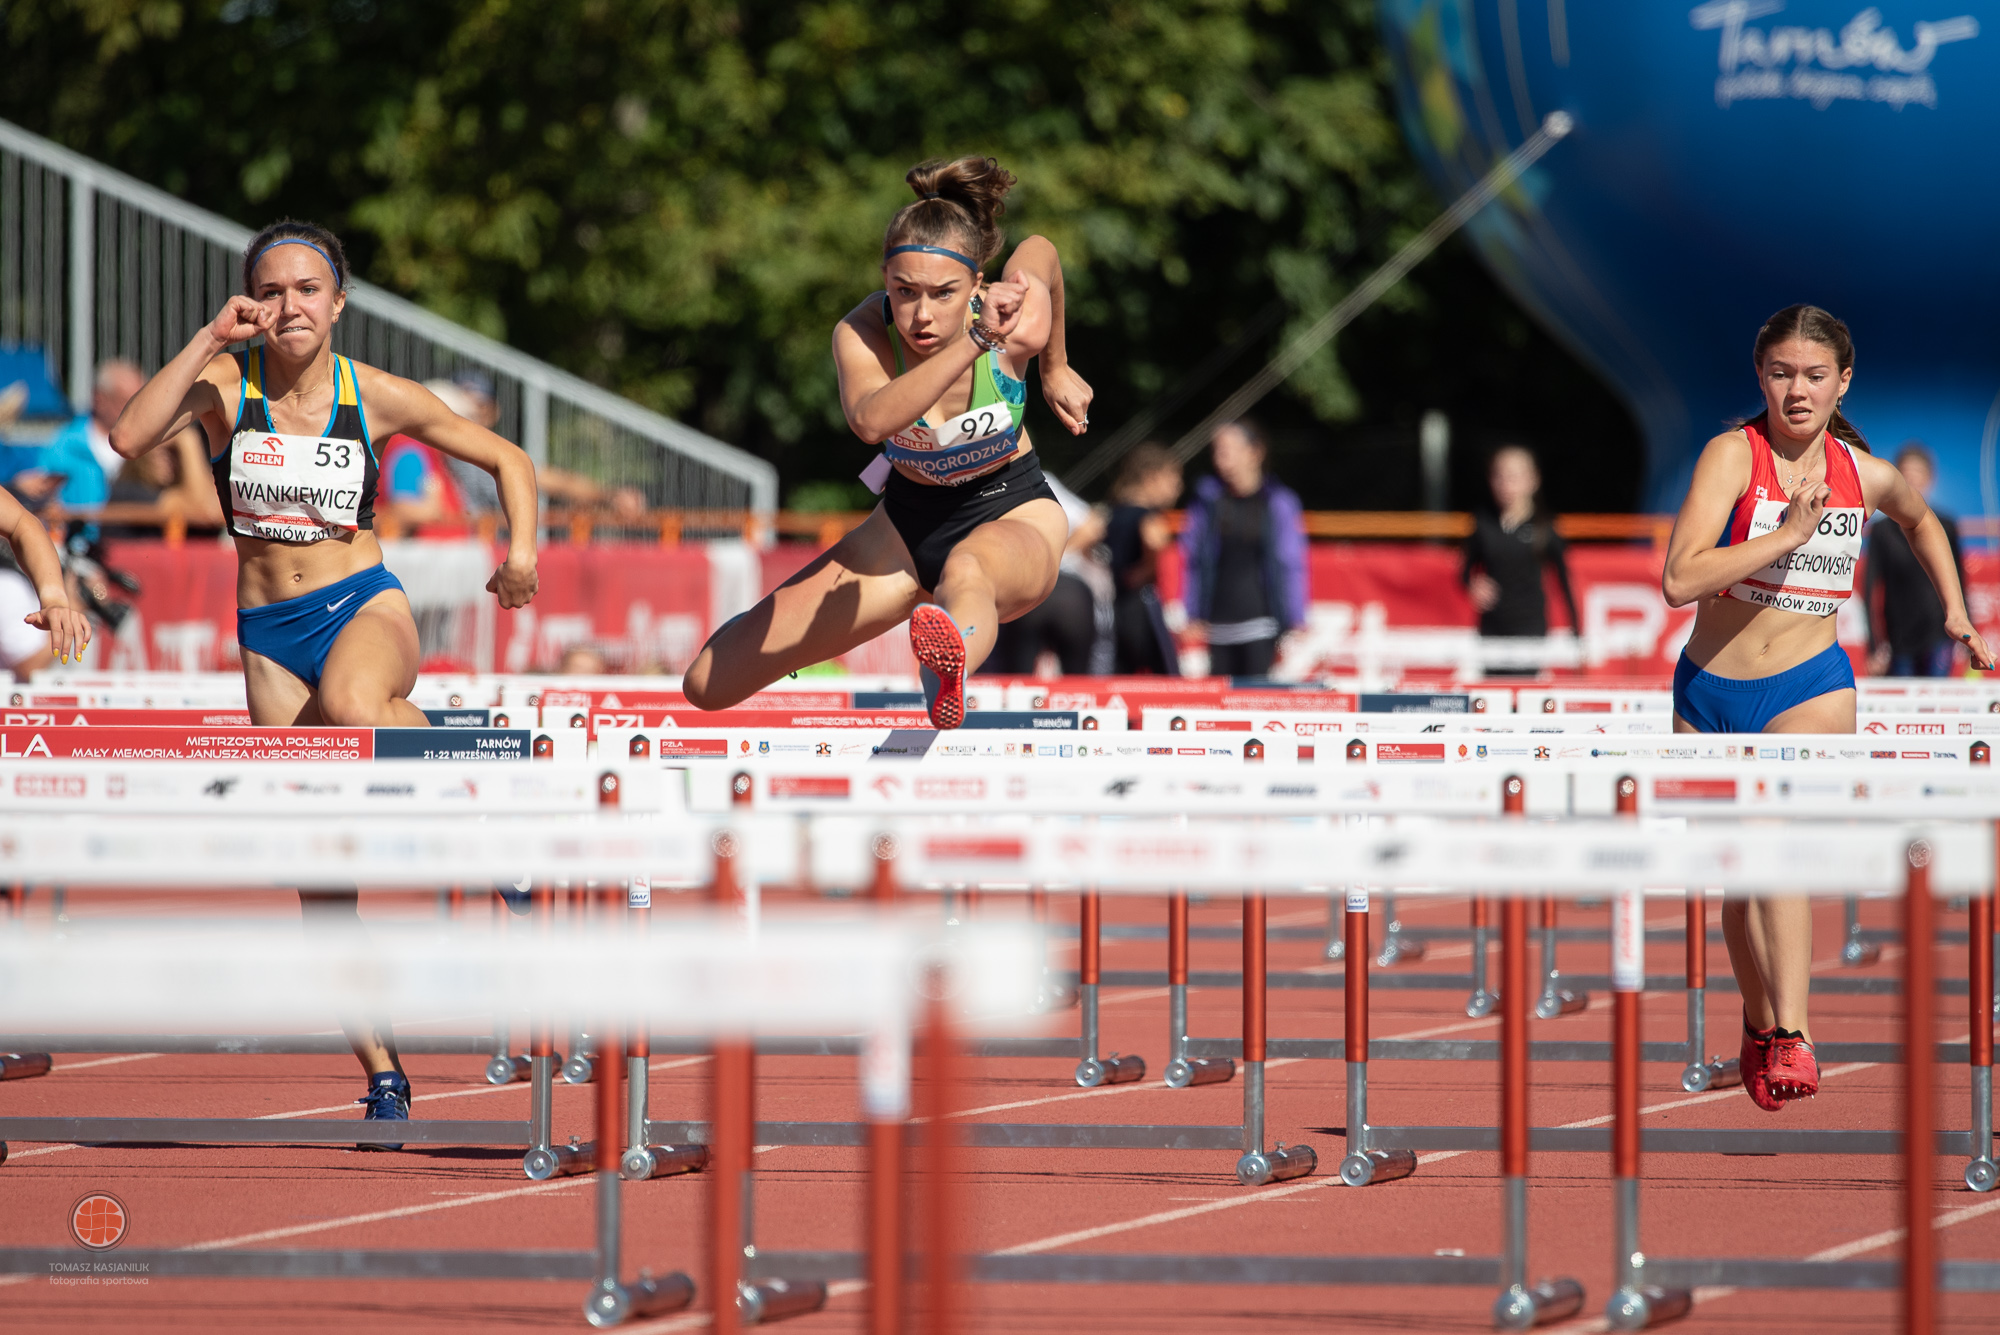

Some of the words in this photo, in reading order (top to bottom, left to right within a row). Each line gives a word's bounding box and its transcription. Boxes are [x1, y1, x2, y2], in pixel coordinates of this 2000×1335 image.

[961, 411, 998, 440] 92
[896, 437, 930, 449] ORLEN
[244, 452, 283, 466] ORLEN
[315, 443, 350, 468] 53
[236, 481, 357, 510] WANKIEWICZ
[1817, 512, 1857, 537] 630
[252, 524, 306, 541] TARNÓW
[310, 525, 339, 541] 2019
[1750, 591, 1804, 610] TARNÓW
[1807, 600, 1833, 613] 2019
[791, 716, 873, 726] MISTRZOSTWA
[875, 716, 916, 726] POLSKI
[1898, 725, 1942, 734] ORLEN
[186, 736, 283, 747] MISTRZOSTWA
[286, 736, 334, 748] POLSKI
[336, 737, 359, 748] U16
[475, 737, 521, 749] TARNÓW
[71, 748, 109, 758] MAŁY
[112, 748, 183, 759] MEMORIAŁ
[185, 748, 249, 759] JANUSZA
[252, 747, 359, 760] KUSOCIŃSKIEGO
[424, 751, 449, 760] 21-22
[451, 750, 498, 761] WRZEŚNIA
[499, 751, 521, 761] 2019
